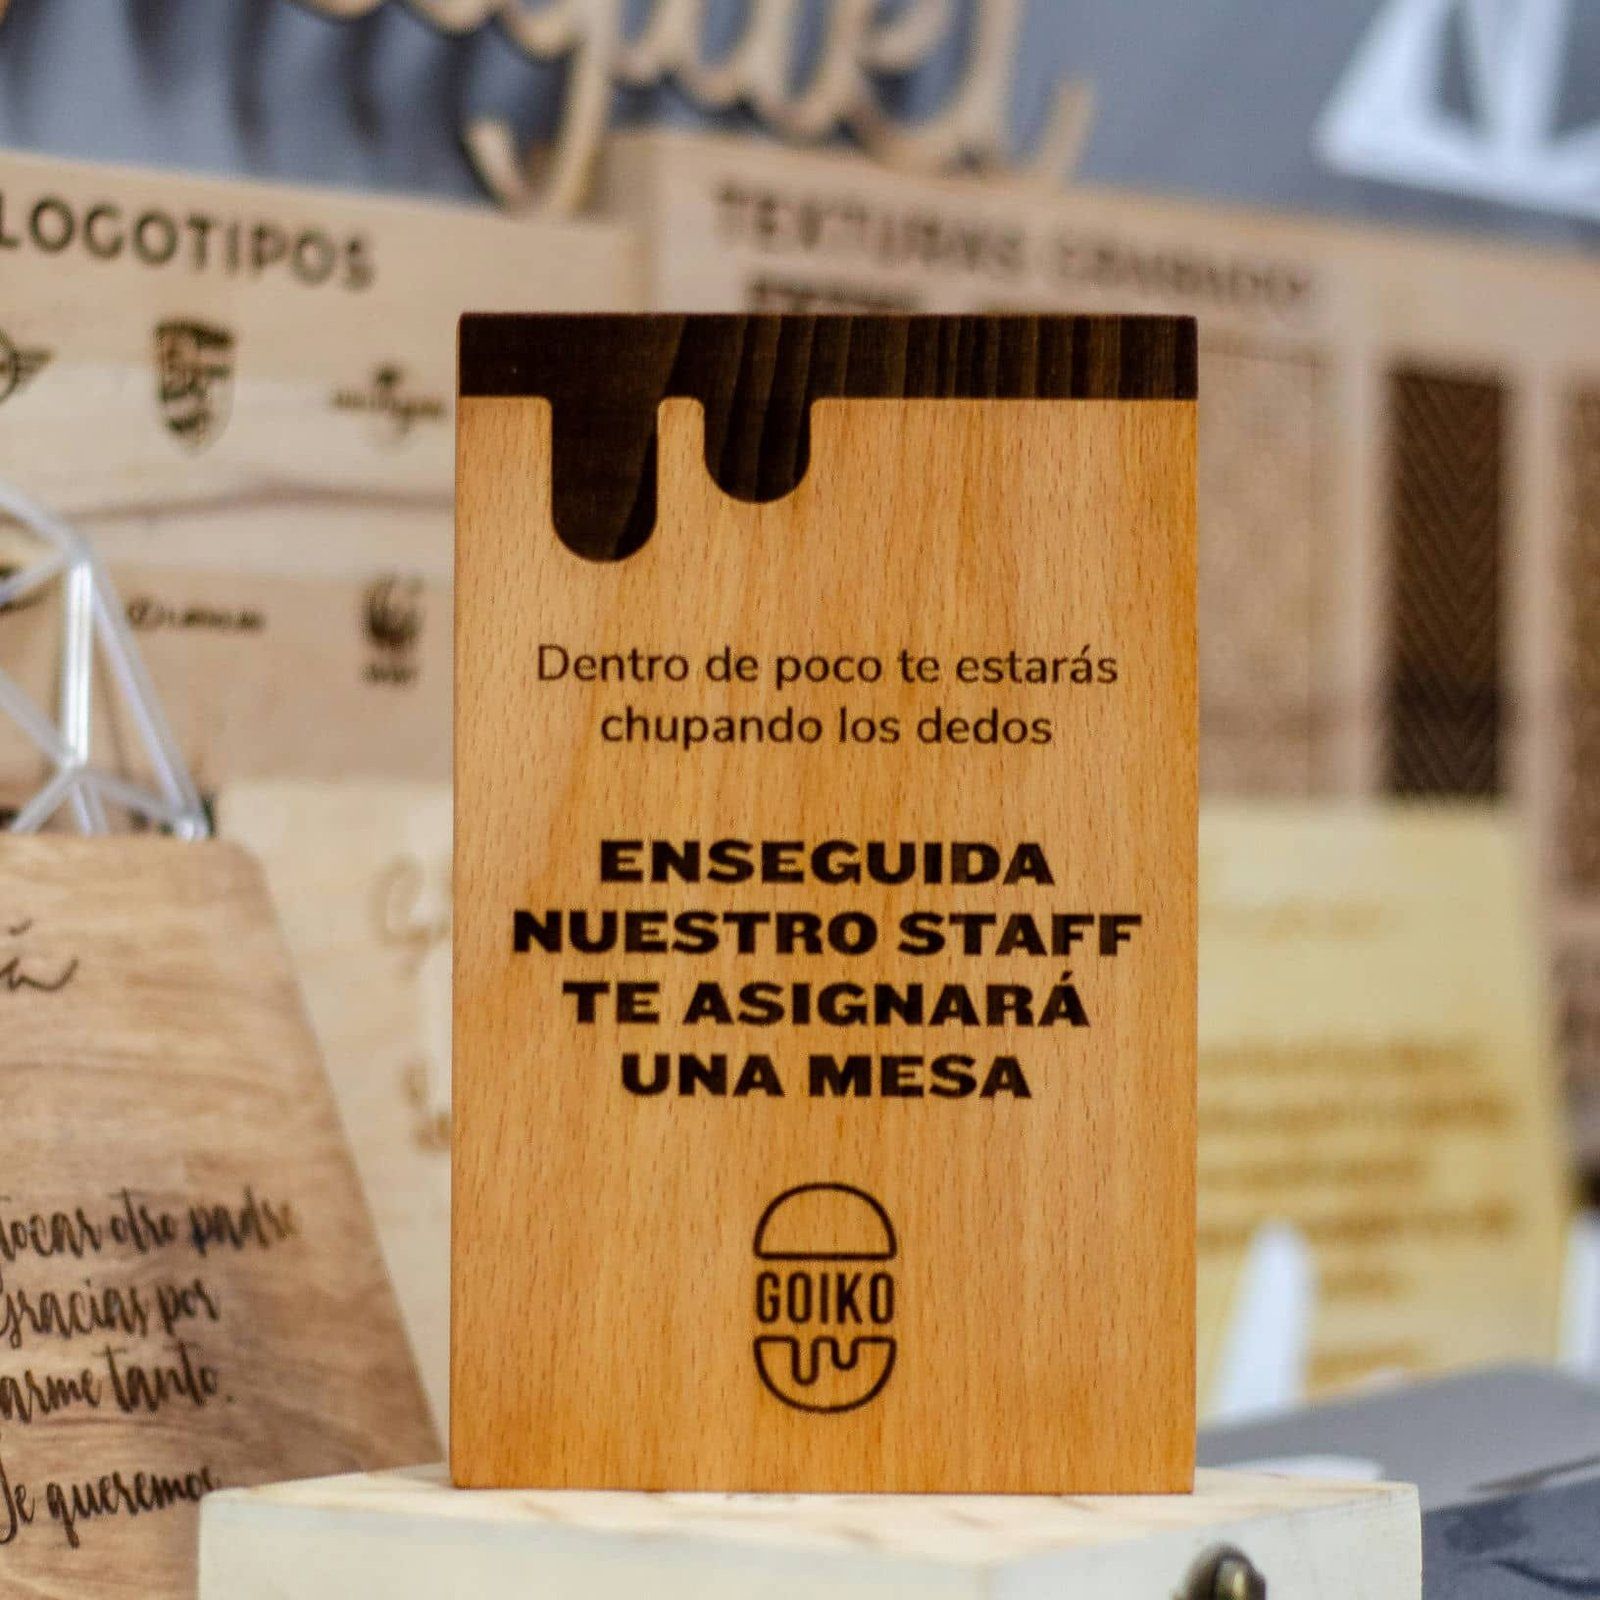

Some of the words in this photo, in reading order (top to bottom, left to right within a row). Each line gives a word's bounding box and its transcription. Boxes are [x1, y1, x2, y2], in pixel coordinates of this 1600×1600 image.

[0, 190, 376, 292] LOGOTIPOS
[538, 645, 689, 682] Dentro
[706, 646, 759, 683] de
[775, 655, 882, 691] poco
[897, 649, 940, 684] te
[955, 644, 1118, 684] estarás
[601, 705, 823, 751] chupando
[839, 706, 900, 744] los
[916, 706, 1052, 744] dedos
[600, 838, 1055, 886] ENSEGUIDA
[513, 909, 878, 957] NUESTRO
[898, 911, 1142, 958] STAFF
[562, 980, 660, 1025] TE
[682, 970, 1090, 1029] ASIGNARÁ
[621, 1053, 784, 1098] UNA
[808, 1053, 1032, 1100] MESA
[155, 1278, 220, 1337] por
[755, 1270, 895, 1325] GOIKO
